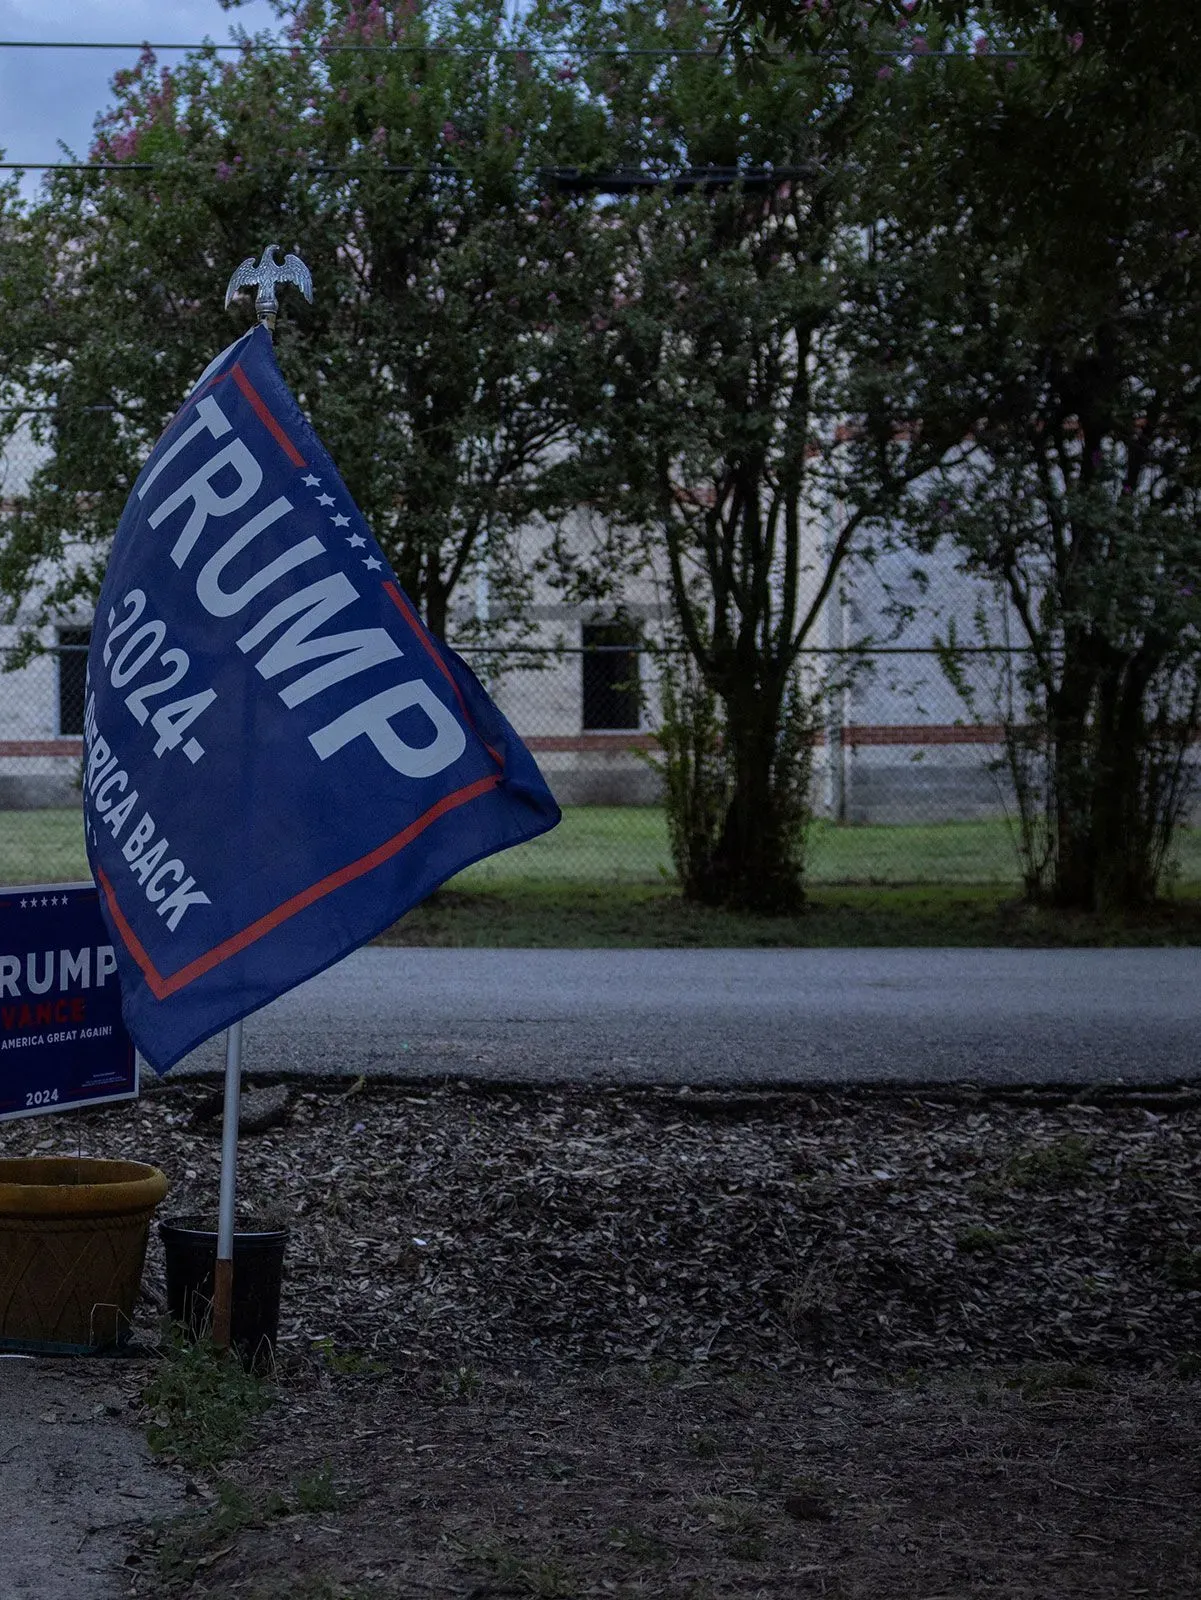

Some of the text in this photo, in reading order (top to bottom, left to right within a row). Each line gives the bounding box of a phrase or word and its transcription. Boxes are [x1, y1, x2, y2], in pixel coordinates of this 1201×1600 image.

[138, 394, 467, 778] TRUMP
[122, 811, 212, 933] BACK
[1, 997, 86, 1030] VANCE
[1, 1034, 44, 1051] AMERICA
[47, 1030, 77, 1043] GREAT
[79, 1025, 112, 1039] AGAIN!
[26, 1088, 59, 1106] 2024
